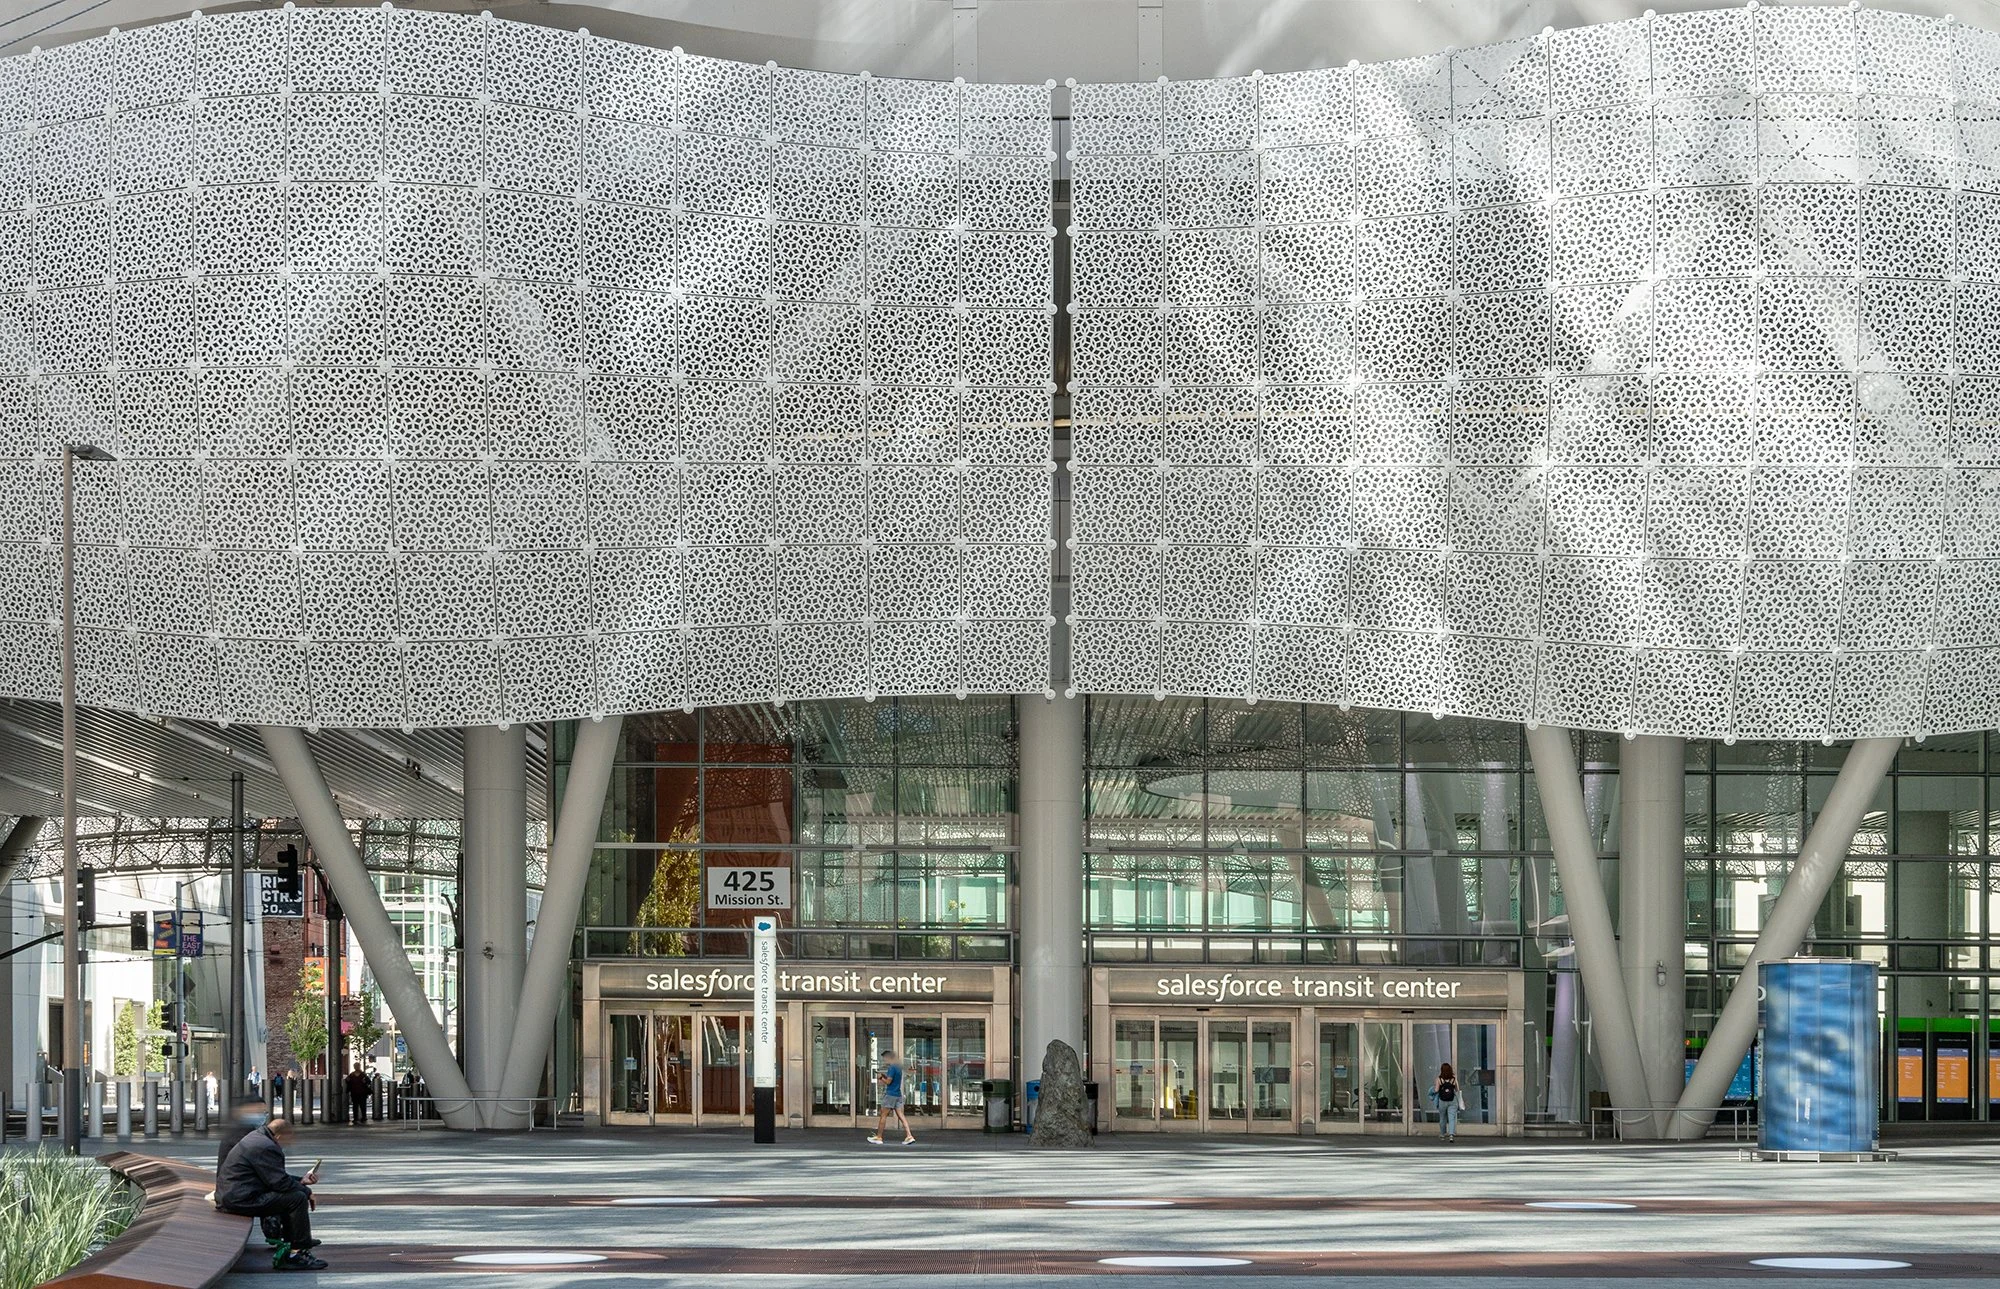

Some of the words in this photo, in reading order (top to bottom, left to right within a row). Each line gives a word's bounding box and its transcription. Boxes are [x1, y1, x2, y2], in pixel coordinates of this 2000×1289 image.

[724, 871, 774, 892] 425
[715, 894, 763, 905] Mission
[767, 894, 784, 905] St.
[183, 934, 196, 942] THE
[759, 941, 770, 984] salesforce
[646, 968, 755, 998] salesforc
[779, 970, 861, 993] transit
[869, 972, 947, 993] center
[1157, 973, 1282, 1002] salesforce
[1291, 975, 1374, 997] transit
[1382, 977, 1461, 998] center
[761, 986, 769, 1015] transit
[760, 1018, 768, 1044] center
